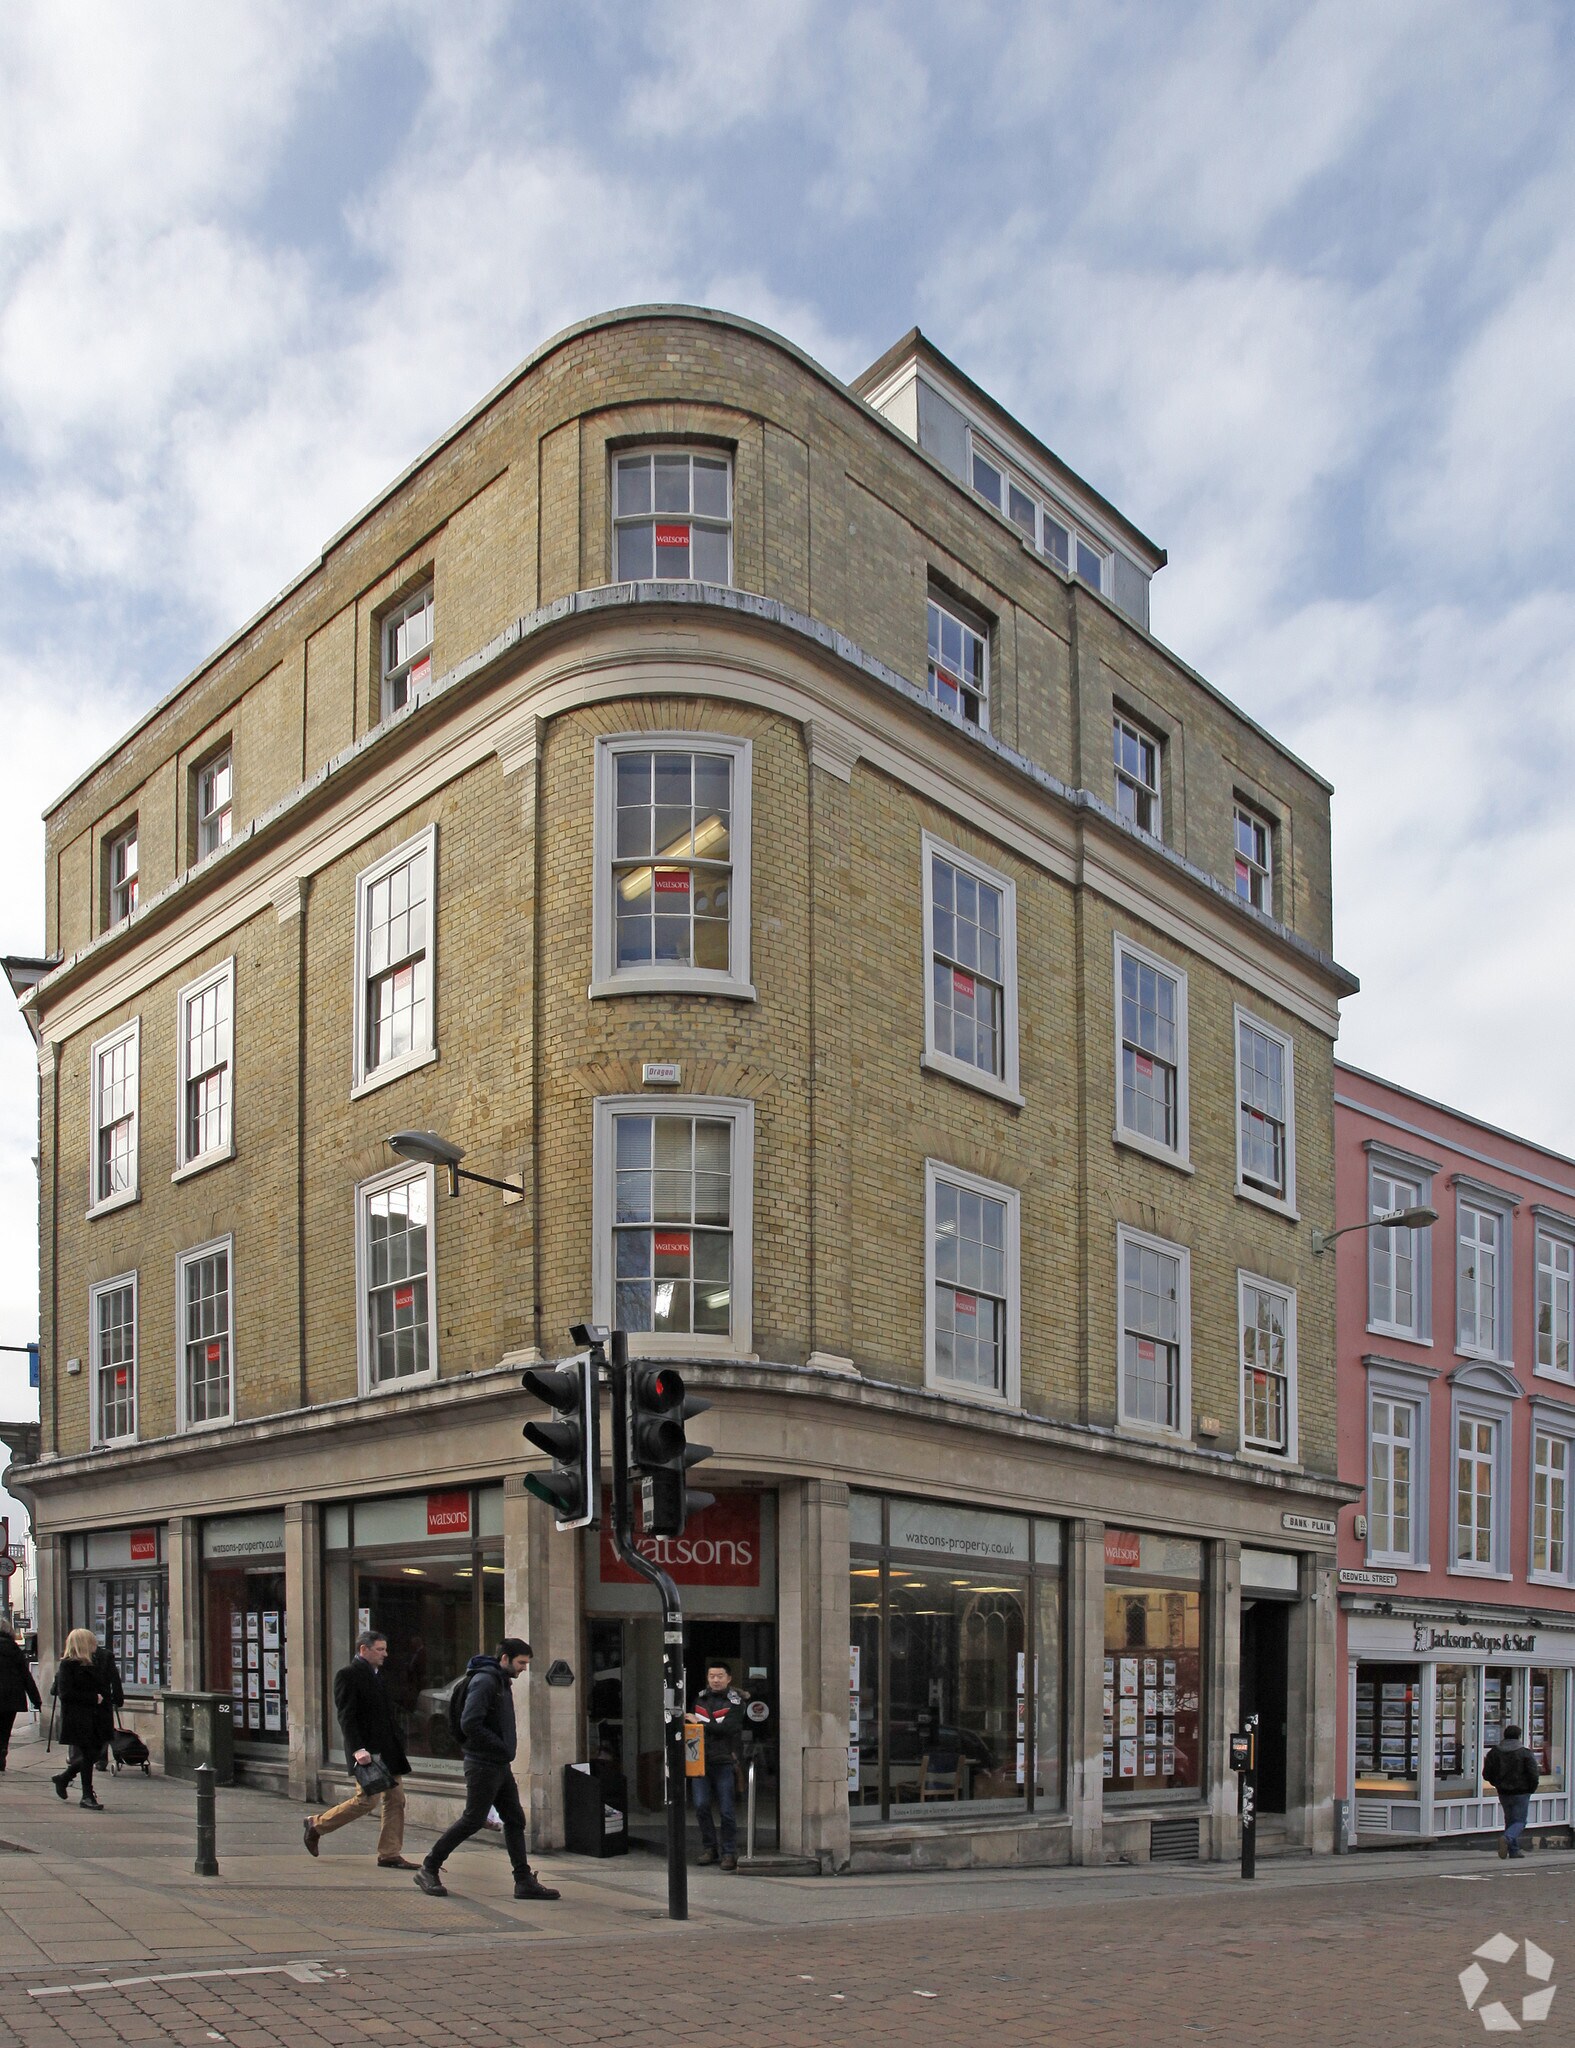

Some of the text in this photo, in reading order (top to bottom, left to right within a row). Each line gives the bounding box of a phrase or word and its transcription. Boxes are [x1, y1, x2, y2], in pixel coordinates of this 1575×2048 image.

[656, 536, 690, 544] watsons
[954, 981, 974, 995] watsons
[649, 1068, 674, 1077] Dragon
[655, 1243, 690, 1251] watsons
[429, 1511, 468, 1526] watsons
[1290, 1517, 1331, 1532] BANK PLAIN
[132, 1542, 155, 1553] watsons
[212, 1536, 284, 1554] watsons-property.co.uk
[903, 1532, 1015, 1555] watsons-property.co.uk
[1105, 1546, 1139, 1561] watsons
[1342, 1571, 1394, 1584] REDWELL STREET
[1429, 1628, 1536, 1655] Jackson-Stops & Staff
[218, 1704, 230, 1713] 52
